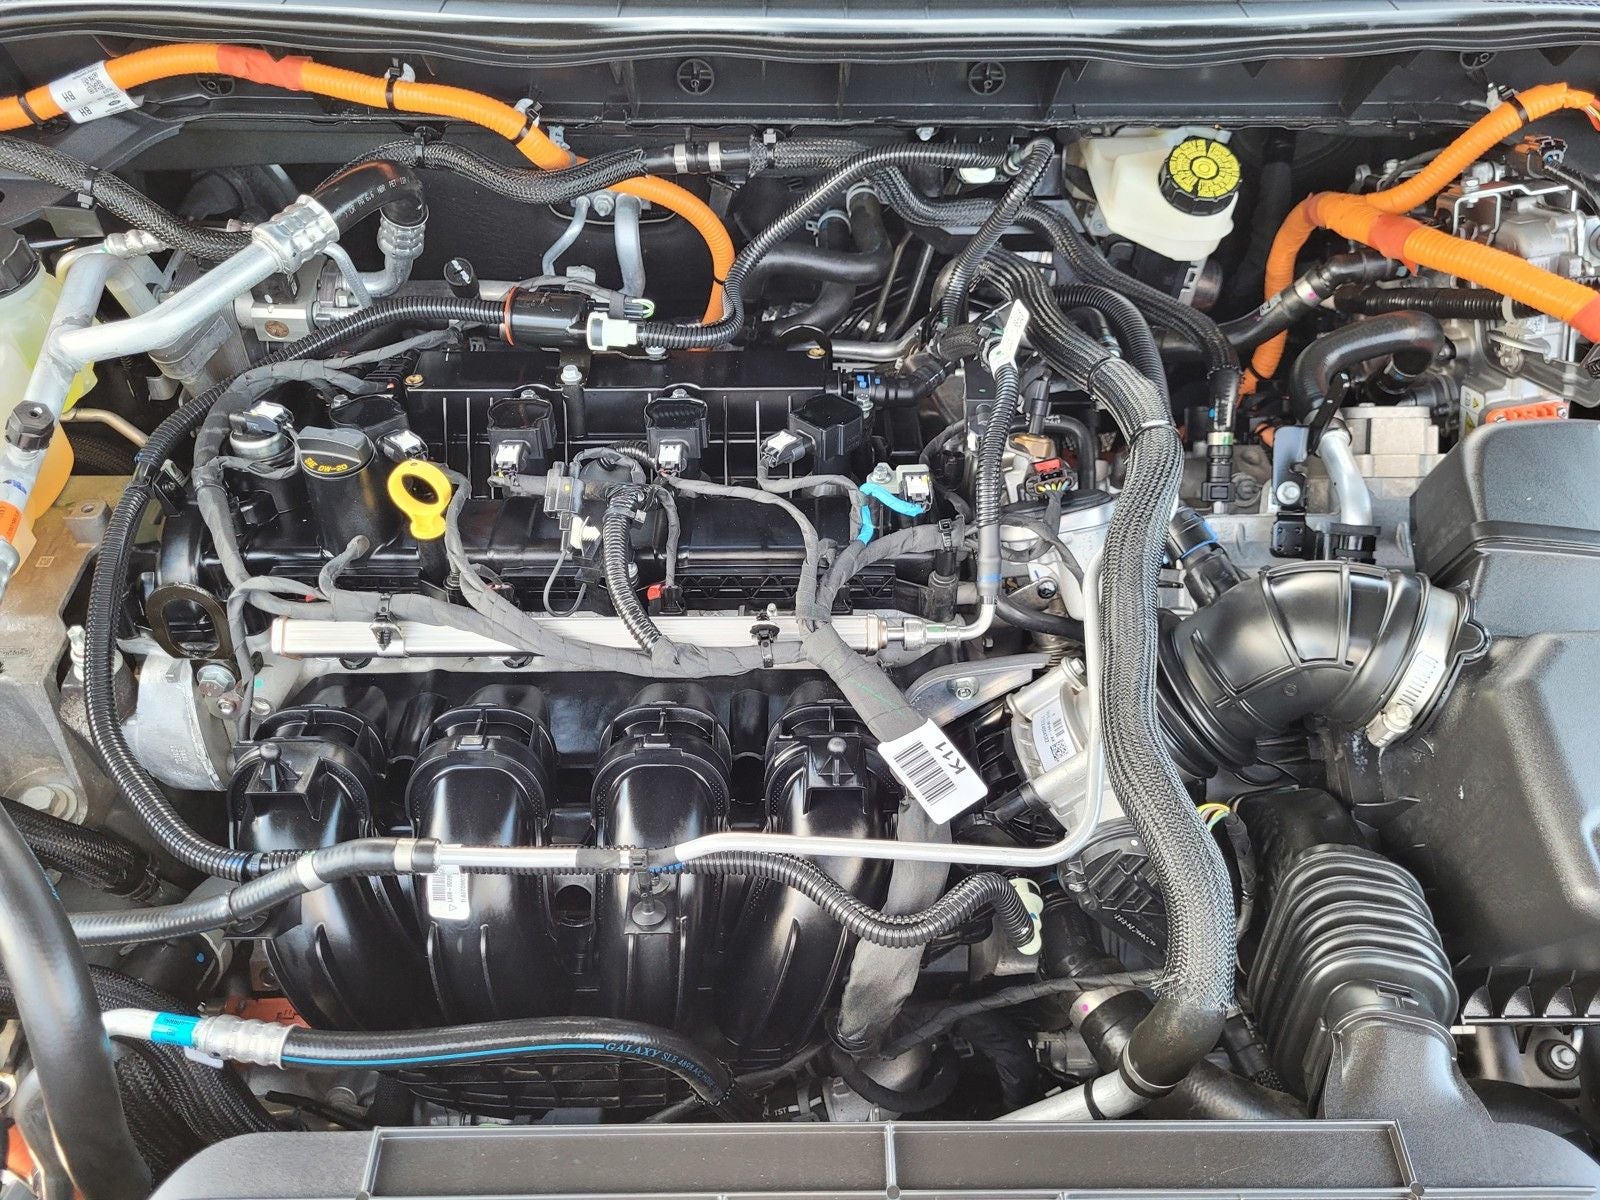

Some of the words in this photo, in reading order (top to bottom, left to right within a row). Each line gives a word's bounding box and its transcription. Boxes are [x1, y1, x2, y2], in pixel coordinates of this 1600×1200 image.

[62, 90, 76, 102] BH
[79, 106, 92, 116] BH
[304, 457, 319, 469] SAE
[934, 741, 967, 775] K11
[605, 1042, 662, 1058] GALAXY
[661, 1051, 679, 1064] SLE
[693, 1066, 706, 1078] AC
